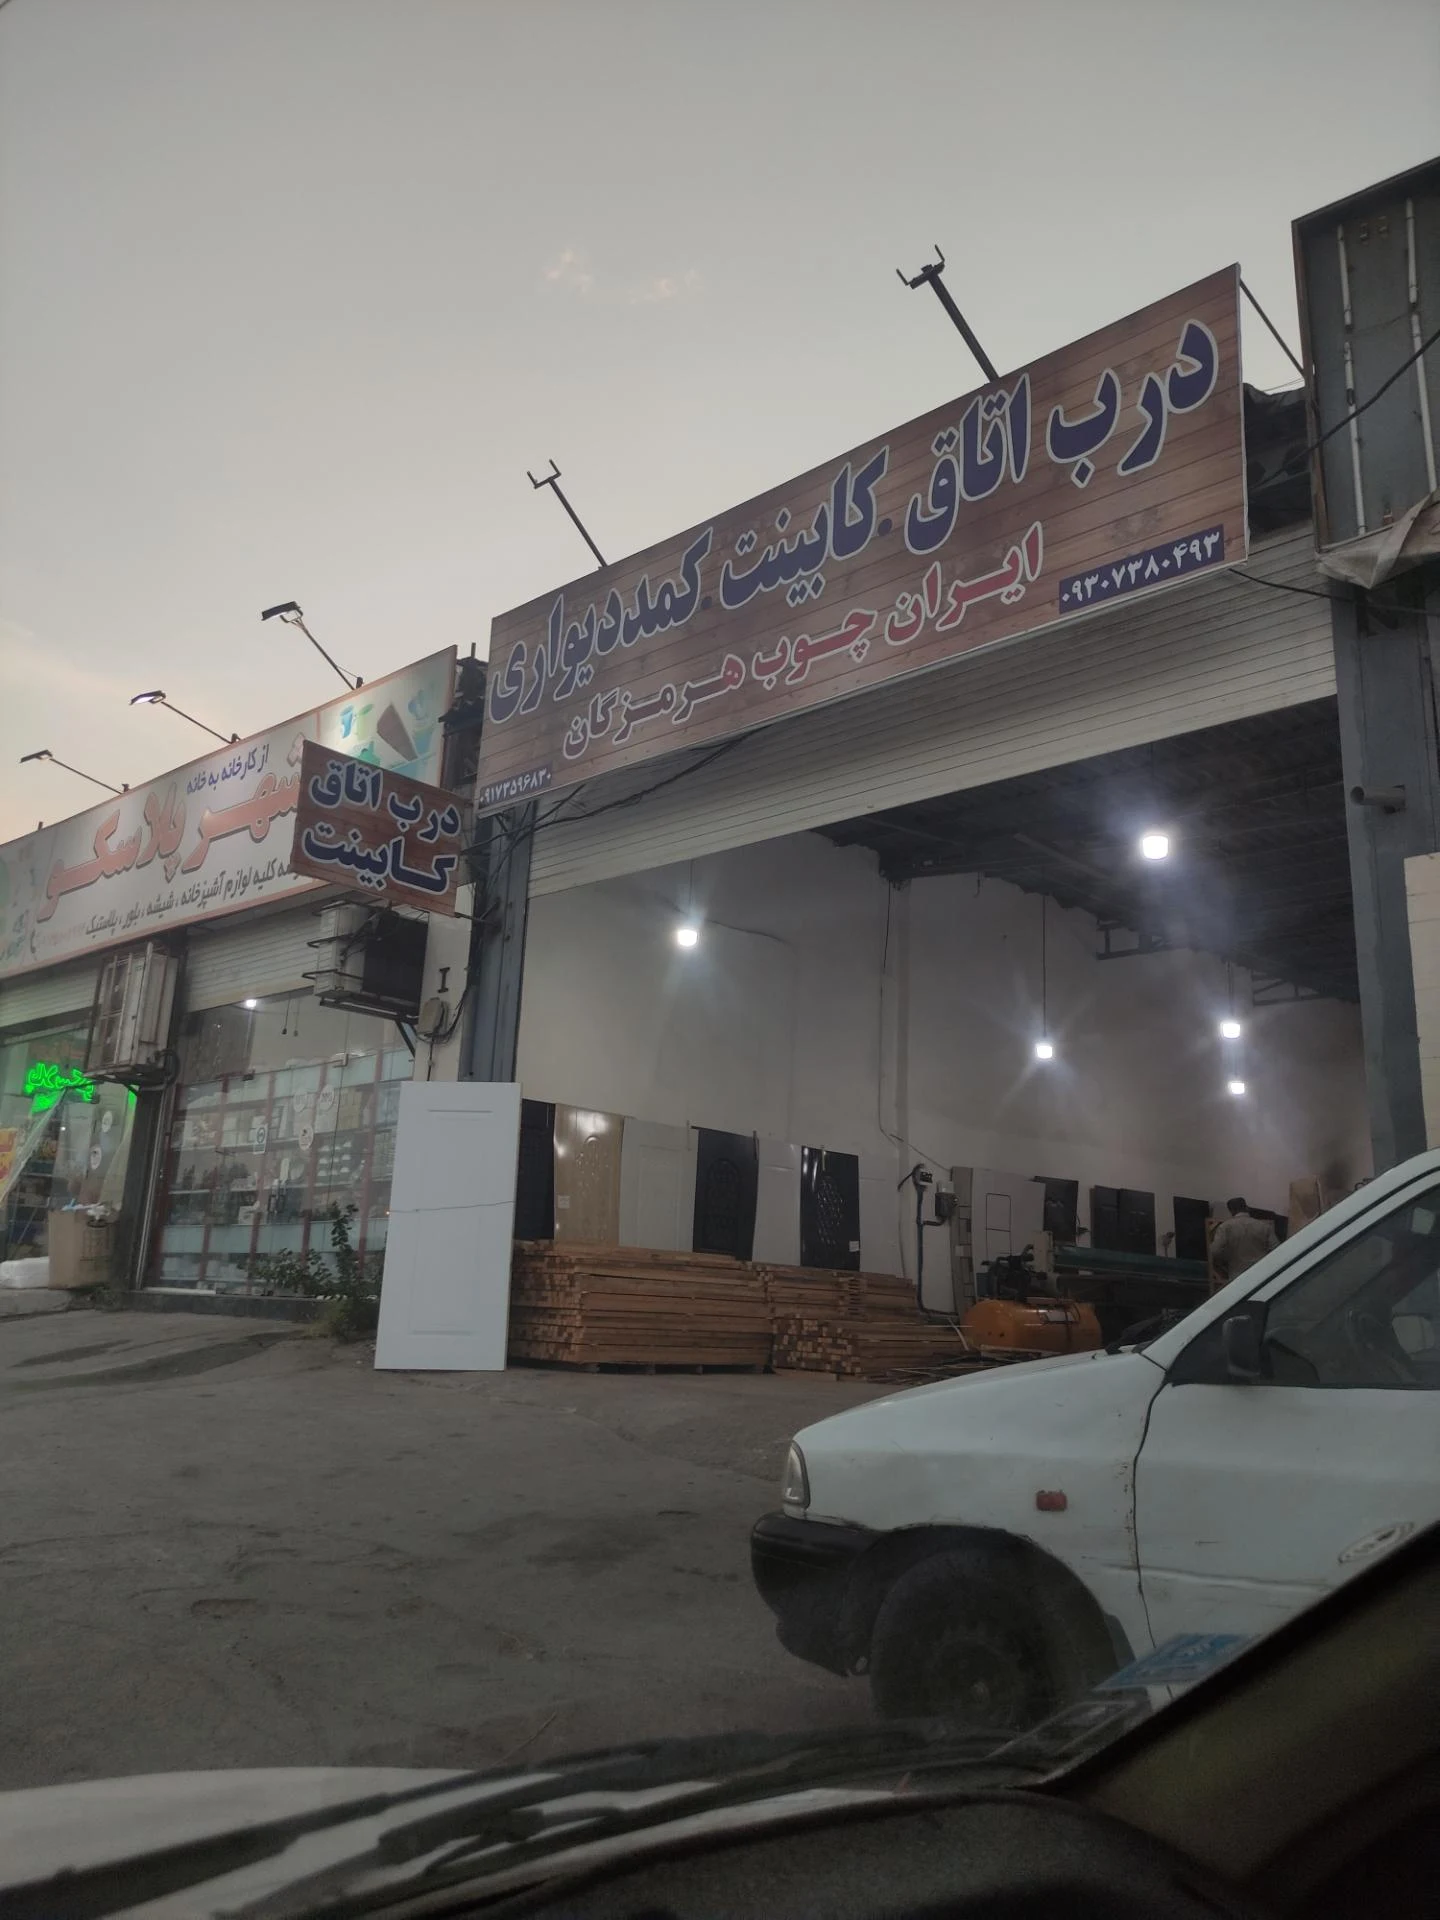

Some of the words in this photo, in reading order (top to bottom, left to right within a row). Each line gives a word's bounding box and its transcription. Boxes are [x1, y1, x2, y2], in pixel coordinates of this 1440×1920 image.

[1047, 319, 1219, 488] درب
[904, 373, 1032, 554] اتاق
[719, 445, 889, 610] کابینت
[884, 521, 1044, 646] ایران
[1062, 531, 1220, 602] ۰۹۳۰۷۳۸۰۴۹۳
[752, 608, 877, 690] چوب
[563, 654, 746, 759] هرمزگان
[186, 772, 206, 795] خانه
[208, 773, 219, 791] به
[221, 748, 257, 780] کارخانه
[257, 743, 270, 772] از
[309, 760, 383, 811] اتاق
[387, 791, 461, 843] درب
[302, 822, 458, 894] کابینت
